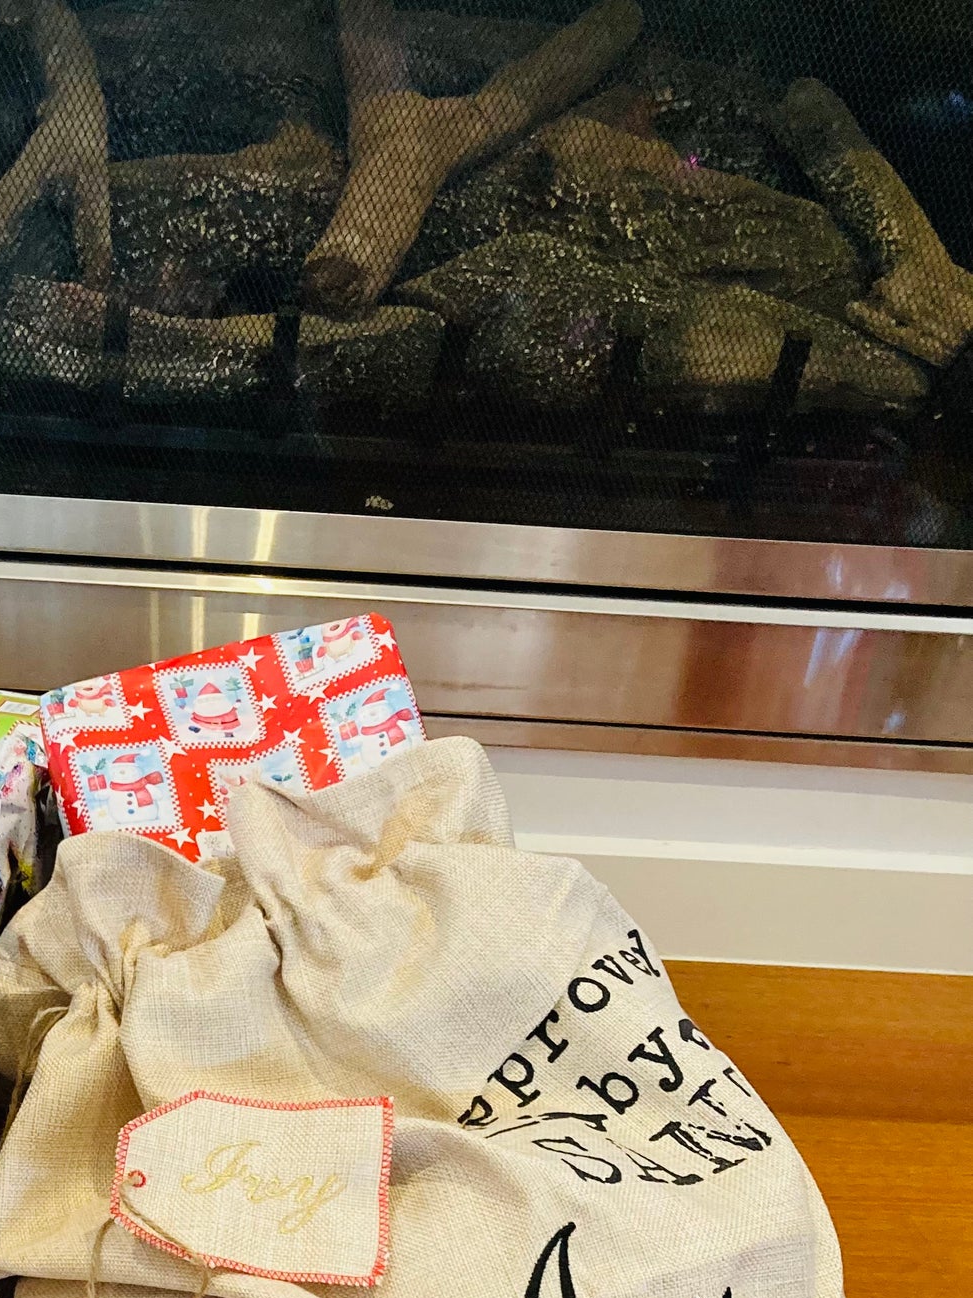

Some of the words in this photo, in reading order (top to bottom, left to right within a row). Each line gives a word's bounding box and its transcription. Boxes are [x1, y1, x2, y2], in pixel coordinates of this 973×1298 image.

[457, 928, 661, 1130] pproved
[576, 1026, 684, 1115] by
[182, 1139, 347, 1234] Ivy
